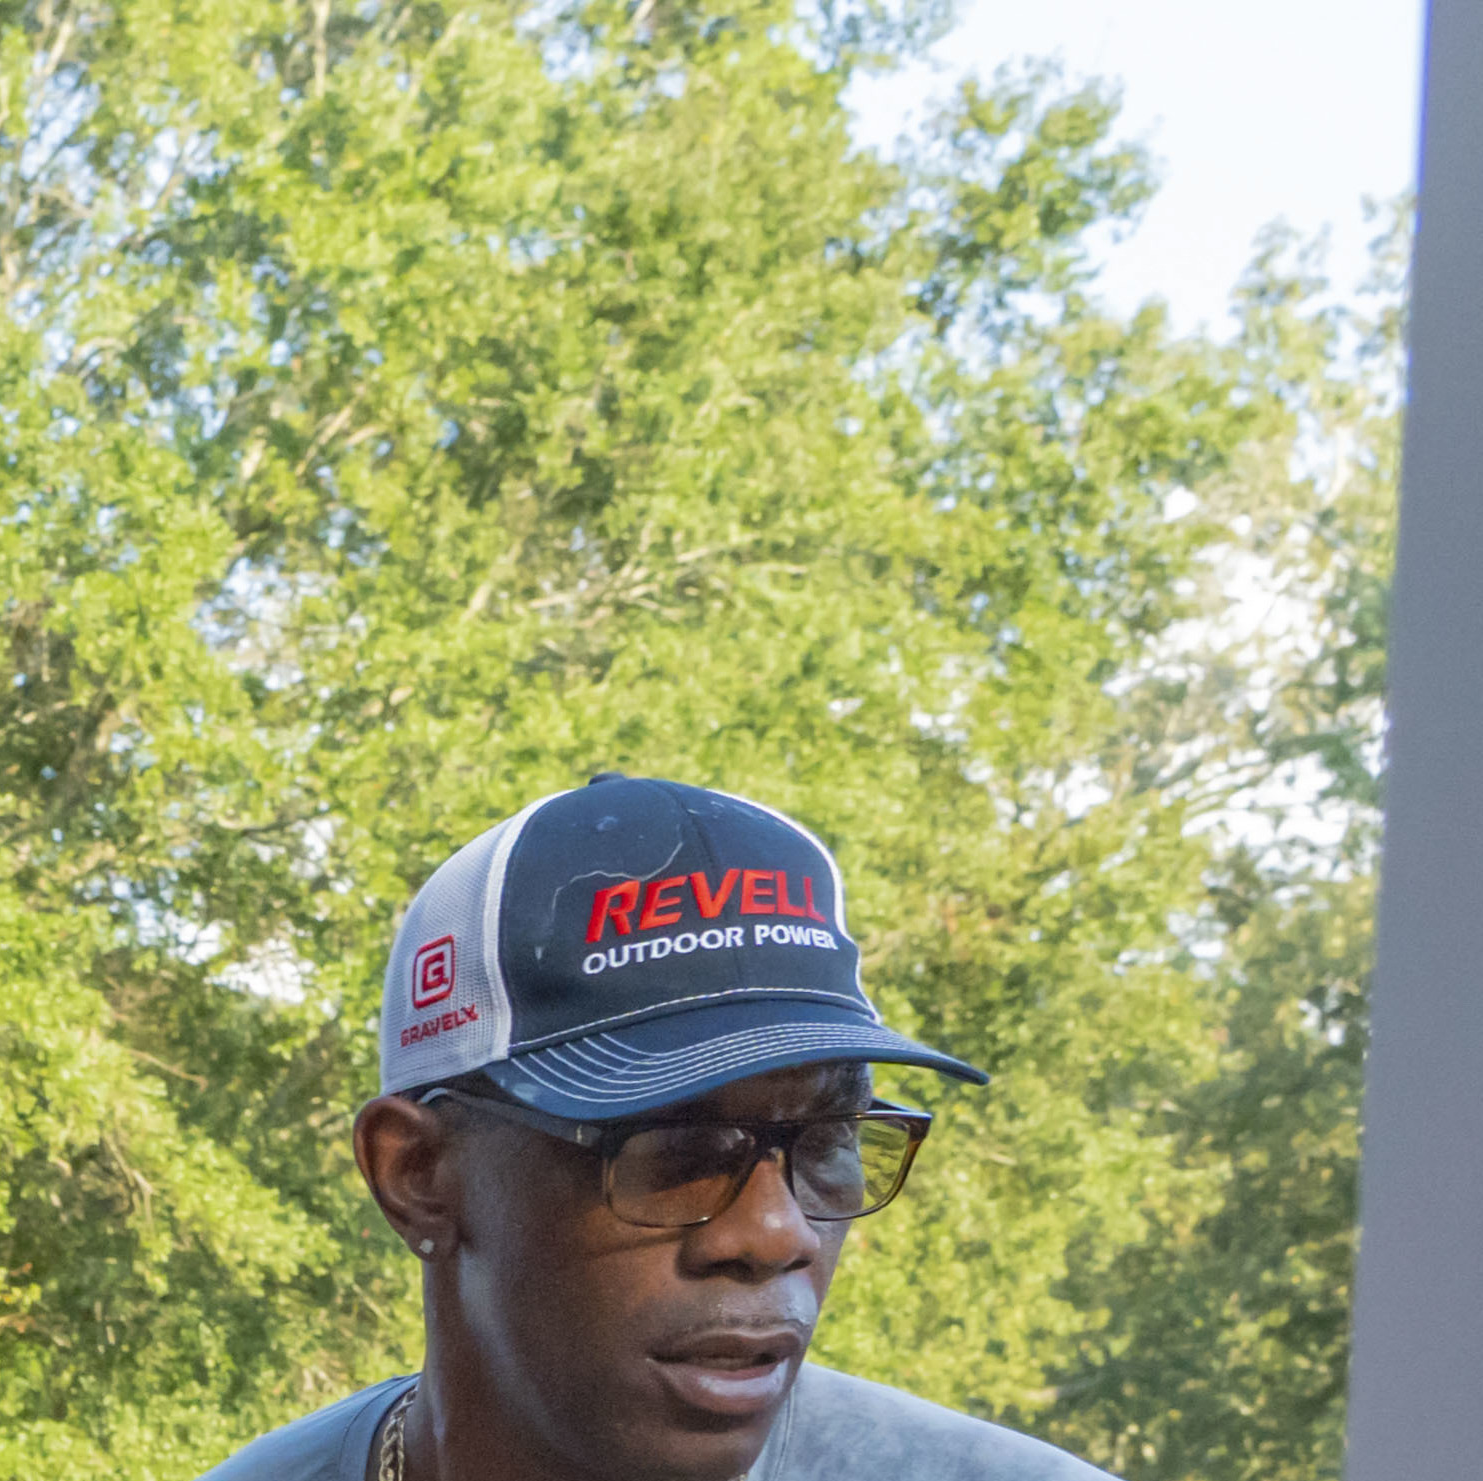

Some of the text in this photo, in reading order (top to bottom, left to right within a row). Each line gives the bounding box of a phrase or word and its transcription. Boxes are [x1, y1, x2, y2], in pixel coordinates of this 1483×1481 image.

[585, 869, 827, 943] REVELL
[582, 924, 838, 975] OUTDOOR POWER
